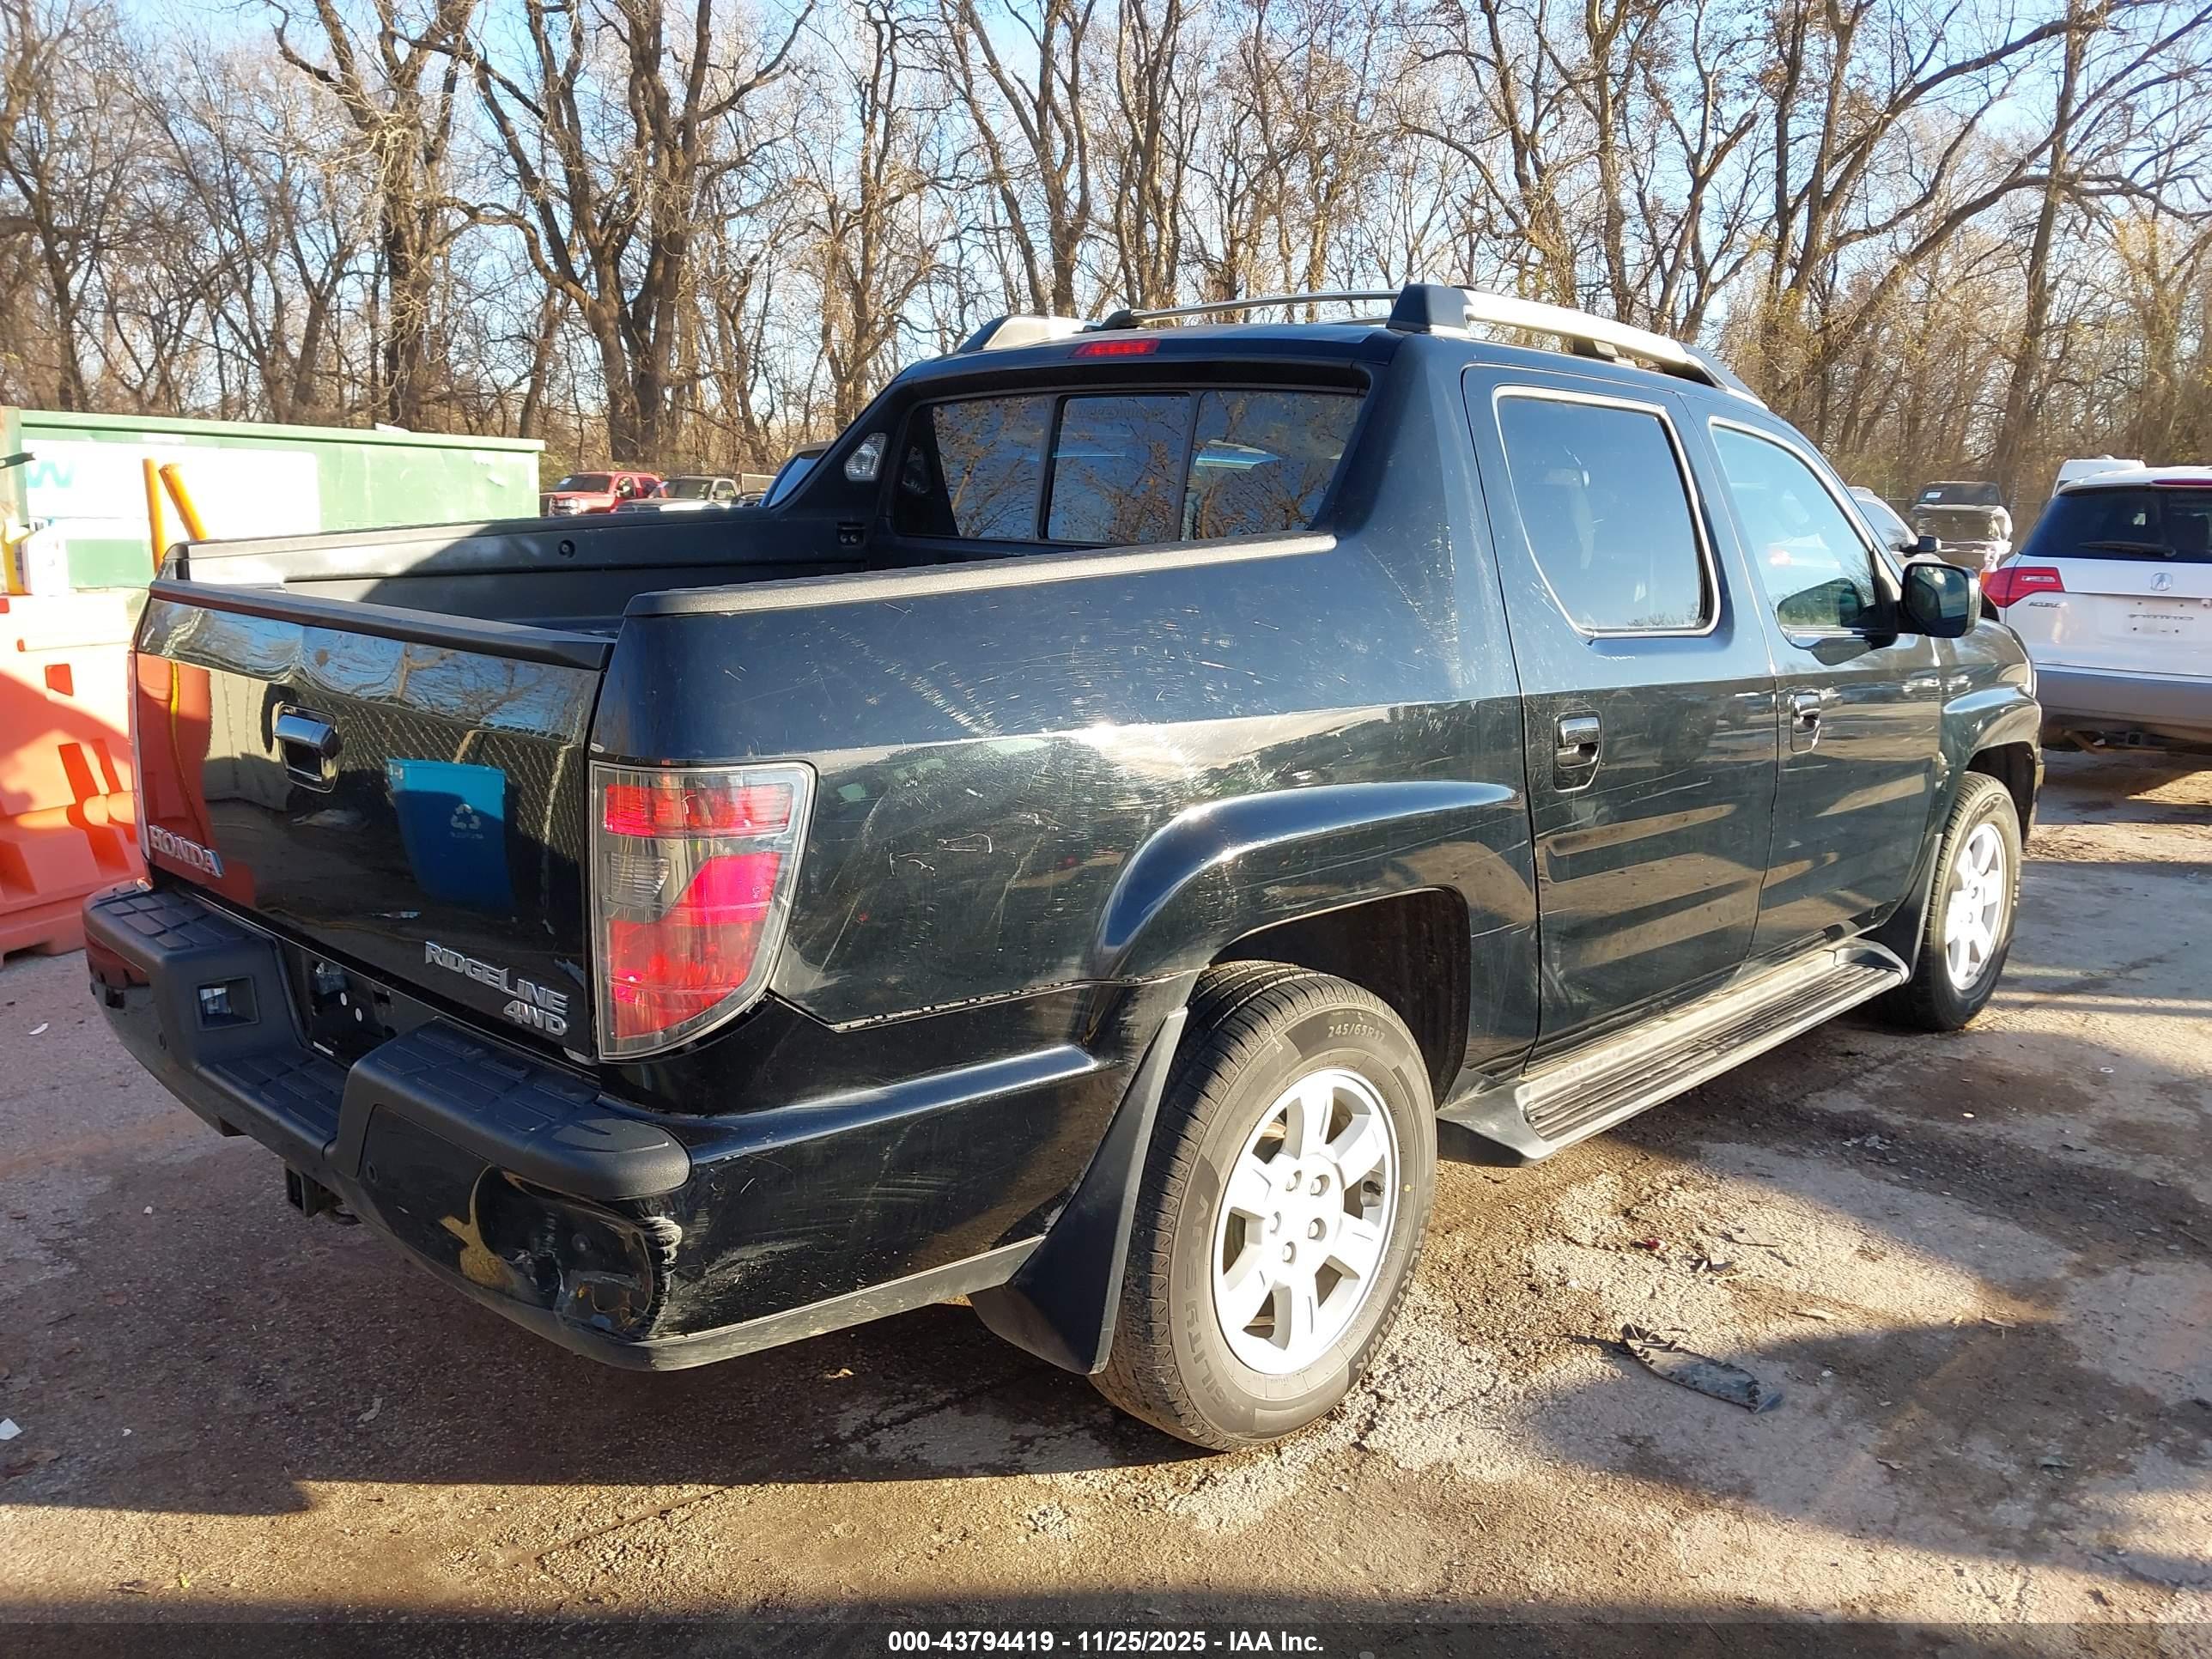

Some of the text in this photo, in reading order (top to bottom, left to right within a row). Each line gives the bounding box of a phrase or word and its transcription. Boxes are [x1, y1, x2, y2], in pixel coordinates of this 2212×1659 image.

[149, 824, 224, 878] HONDA
[425, 940, 569, 1016] RIDGELINE
[503, 1000, 569, 1036] 4WD
